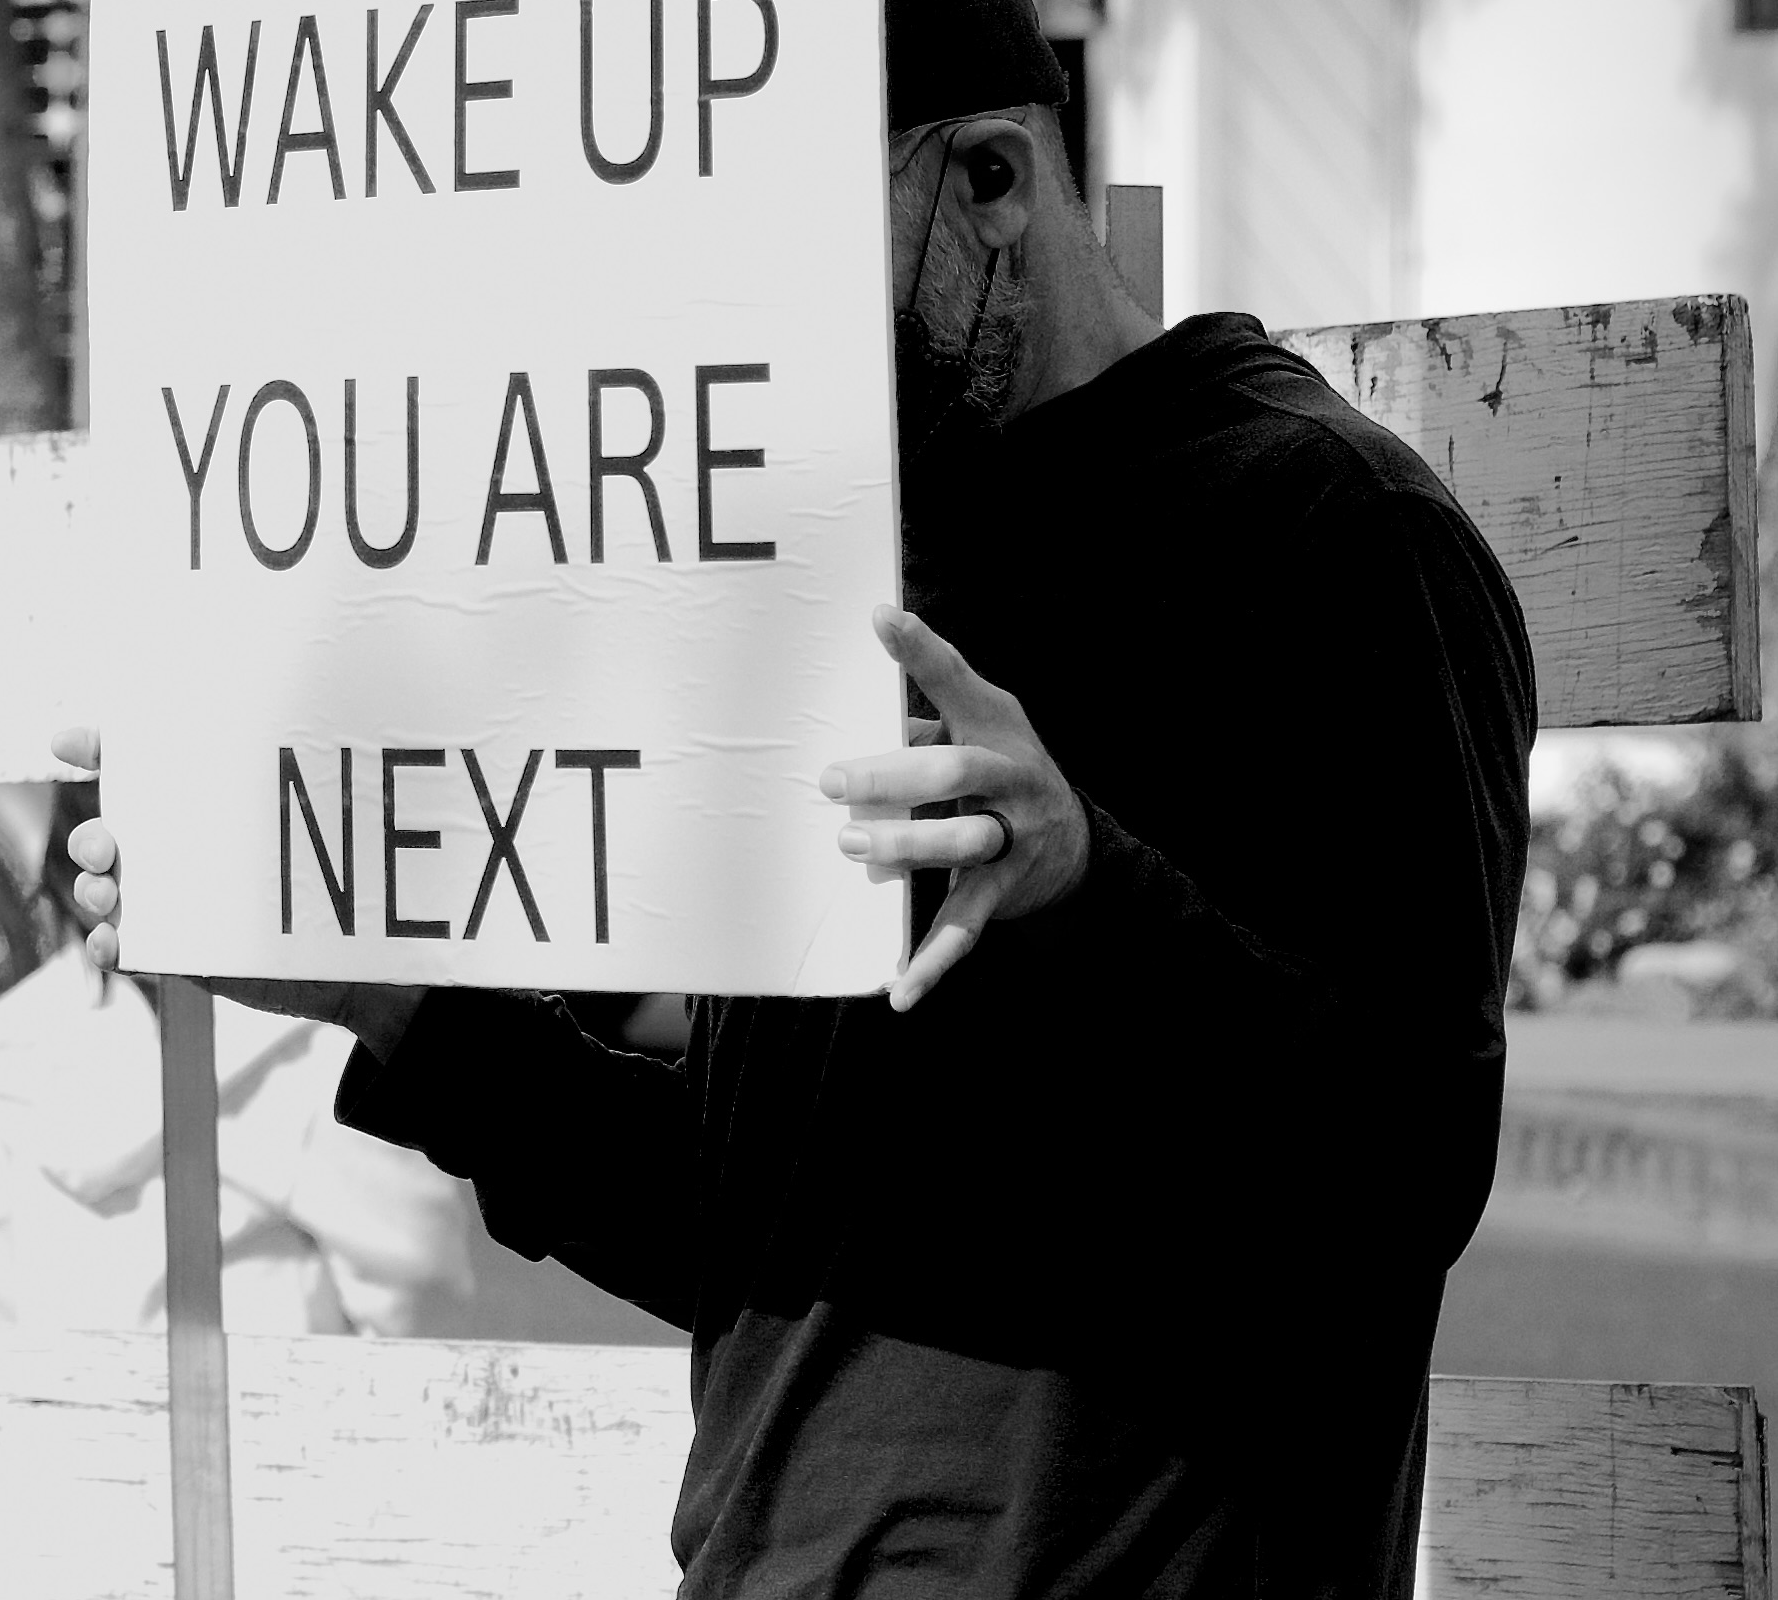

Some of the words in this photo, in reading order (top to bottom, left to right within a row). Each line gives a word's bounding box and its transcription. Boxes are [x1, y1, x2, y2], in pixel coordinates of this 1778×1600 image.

[161, 376, 419, 571] YOU
[475, 363, 777, 565] ARE
[279, 747, 641, 943] NEXT
